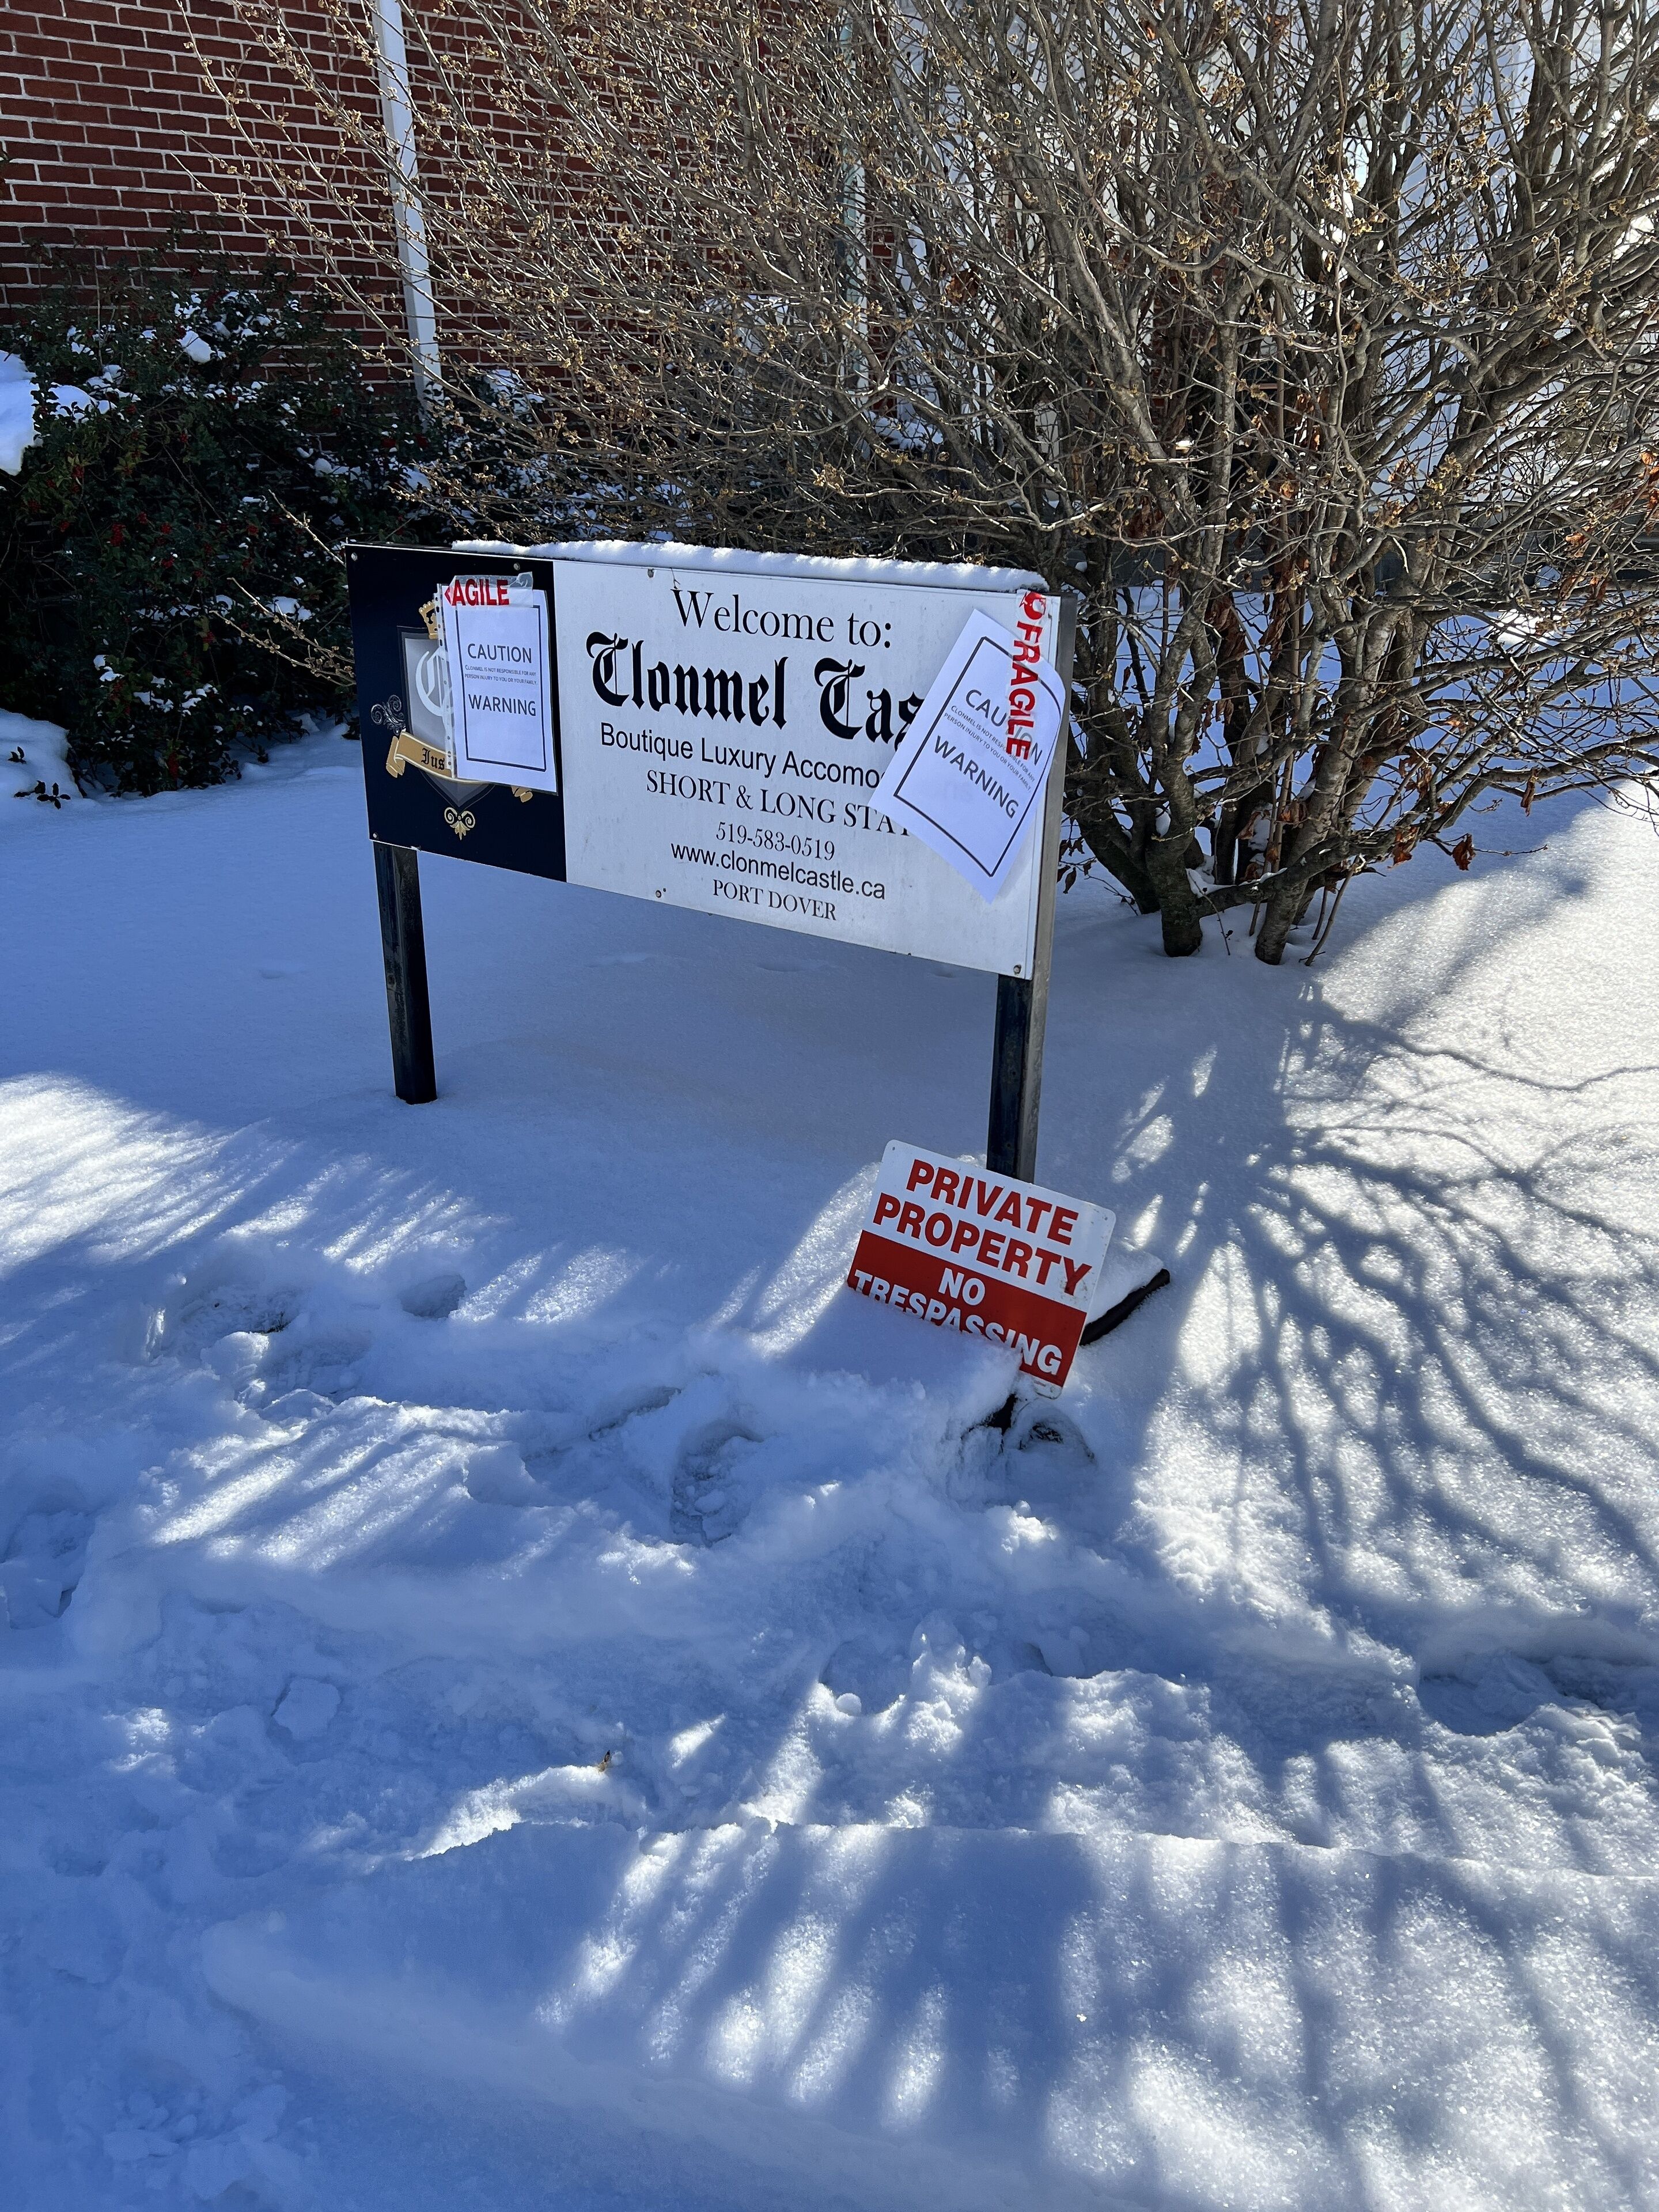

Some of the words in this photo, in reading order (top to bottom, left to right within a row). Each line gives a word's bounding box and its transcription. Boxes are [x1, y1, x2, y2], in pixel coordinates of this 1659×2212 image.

[445, 579, 510, 606] AGILE
[671, 588, 835, 642] Welcome
[847, 612, 892, 648] to:
[468, 643, 532, 663] CAUTION
[468, 694, 536, 717] WARNING
[586, 631, 789, 730] Clonmel
[814, 657, 925, 752] Cas
[1006, 621, 1043, 760] FRAGILE
[601, 722, 693, 762] Boutique
[702, 738, 777, 778] Luxury
[782, 751, 885, 789] Accomo
[944, 713, 965, 730] PERSON
[965, 727, 983, 744] INJURY
[983, 740, 990, 749] TO
[990, 746, 1001, 757] YOU
[1000, 756, 1007, 765] OR
[1007, 763, 1020, 776] YOUR
[981, 728, 992, 738] NOT
[1021, 762, 1029, 775] FOR
[1027, 771, 1036, 783] ANY
[647, 770, 730, 805] SHORT
[736, 785, 753, 810] &
[761, 789, 835, 824] LONG
[843, 802, 910, 836] STA
[934, 735, 1018, 819] WARNING
[671, 842, 885, 900] www.clonmelcastle.ca
[715, 821, 835, 861] 519-583-0519
[713, 880, 764, 906] PORT
[768, 895, 836, 921] DOVER
[906, 1158, 1078, 1245] PRIVATE
[873, 1192, 1092, 1296] PROPERTY
[938, 1267, 986, 1306] NO
